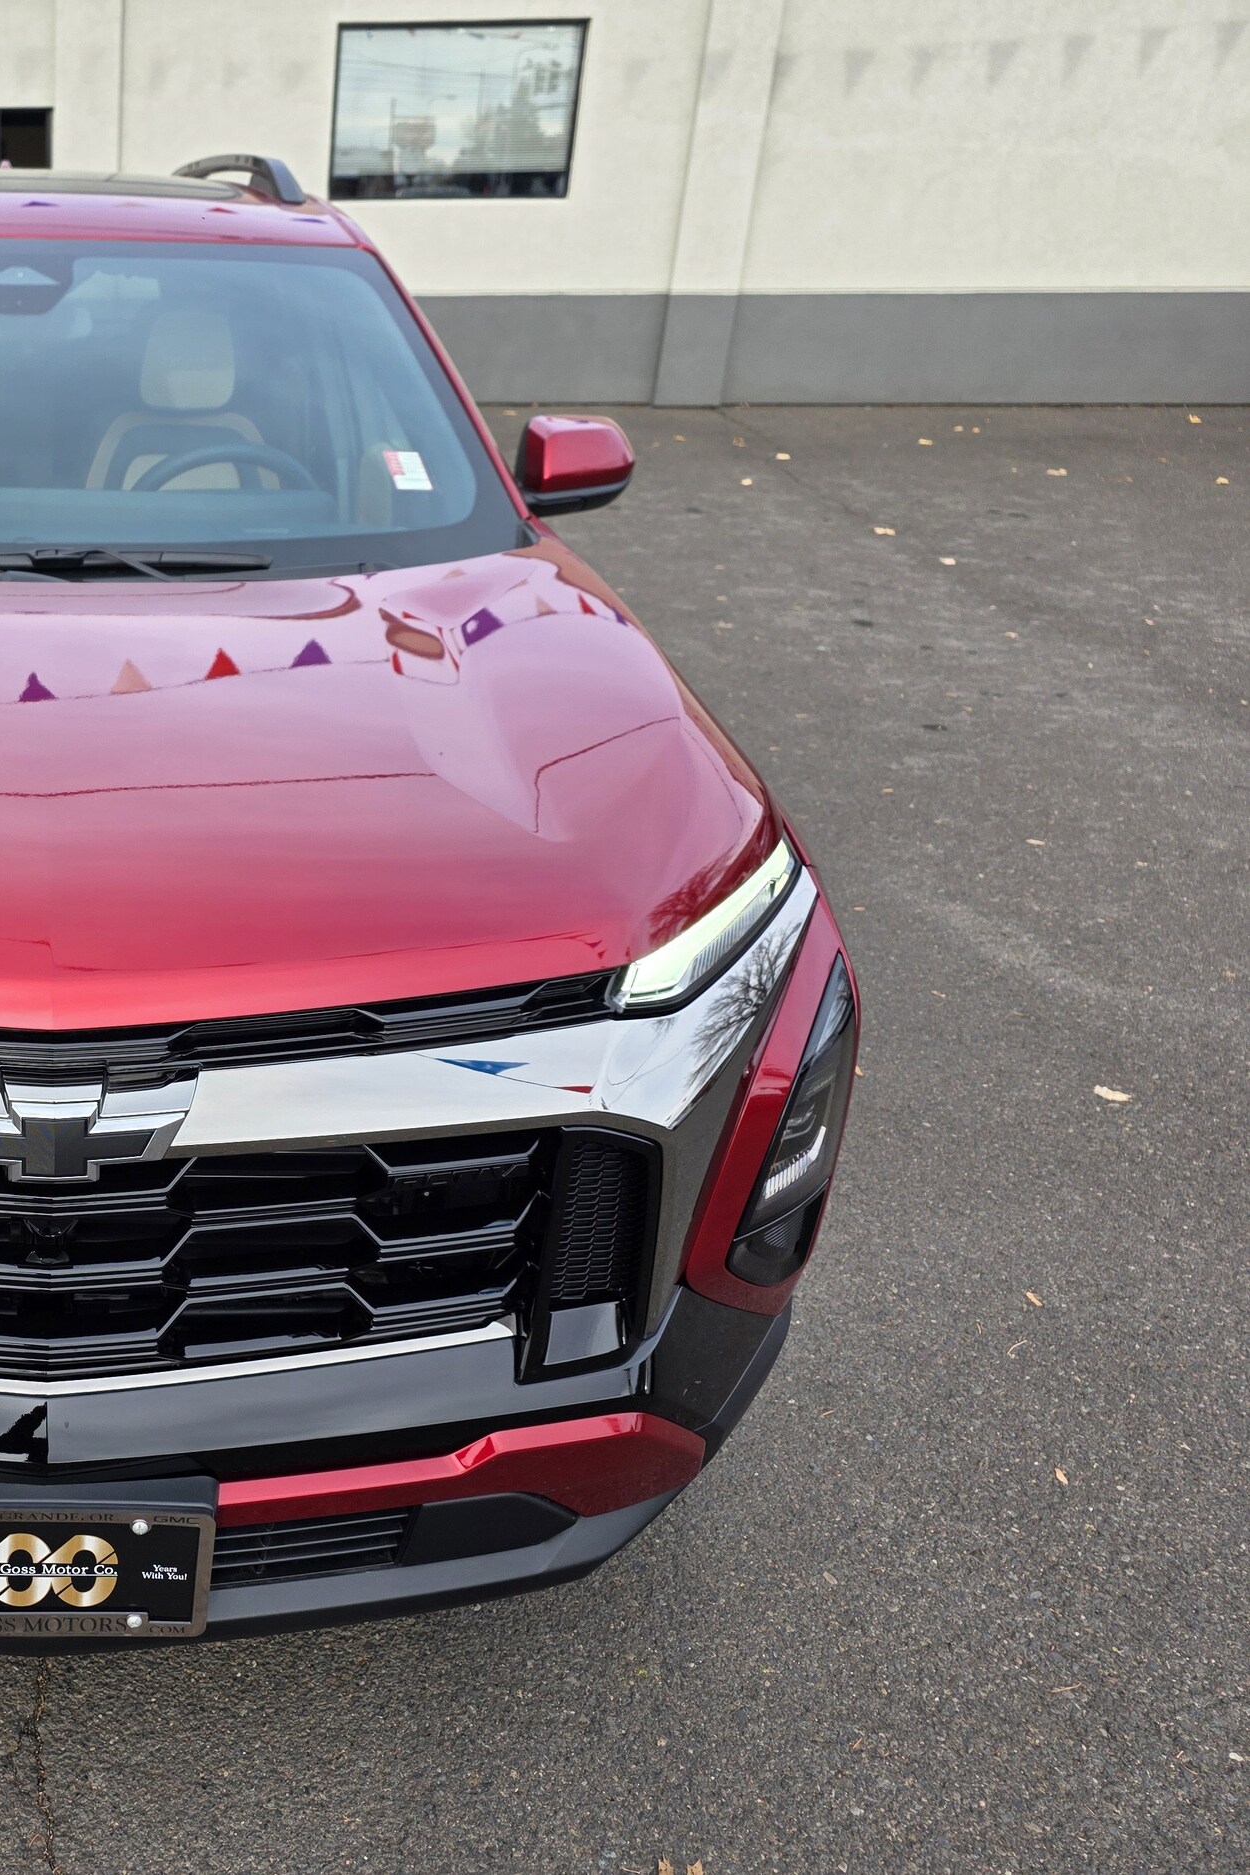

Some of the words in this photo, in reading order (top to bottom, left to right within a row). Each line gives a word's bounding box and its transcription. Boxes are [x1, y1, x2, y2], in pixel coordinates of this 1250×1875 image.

[89, 1513, 114, 1521] OR
[154, 1515, 200, 1524] GMC
[0, 1563, 37, 1575] Goss
[42, 1563, 89, 1575] Motor
[93, 1563, 118, 1576] Co.
[152, 1564, 178, 1573] Years
[141, 1571, 164, 1580] With
[166, 1572, 188, 1581] You!
[23, 1617, 128, 1633] MOTORS
